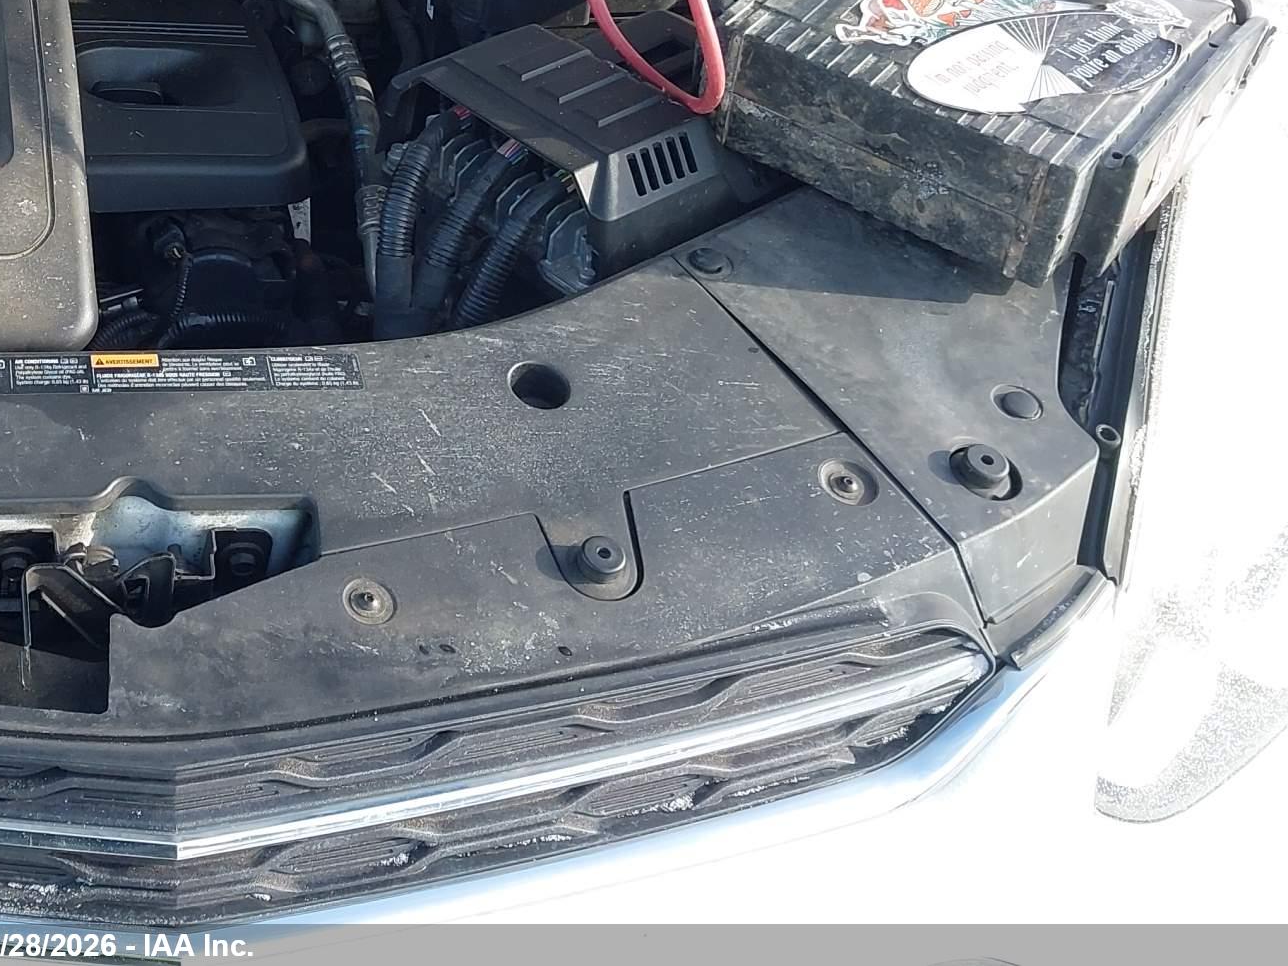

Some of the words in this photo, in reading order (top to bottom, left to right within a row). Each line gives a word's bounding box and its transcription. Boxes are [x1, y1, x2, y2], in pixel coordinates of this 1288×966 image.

[1062, 37, 1098, 61] just
[1084, 19, 1124, 43] think
[1100, 49, 1124, 64] an
